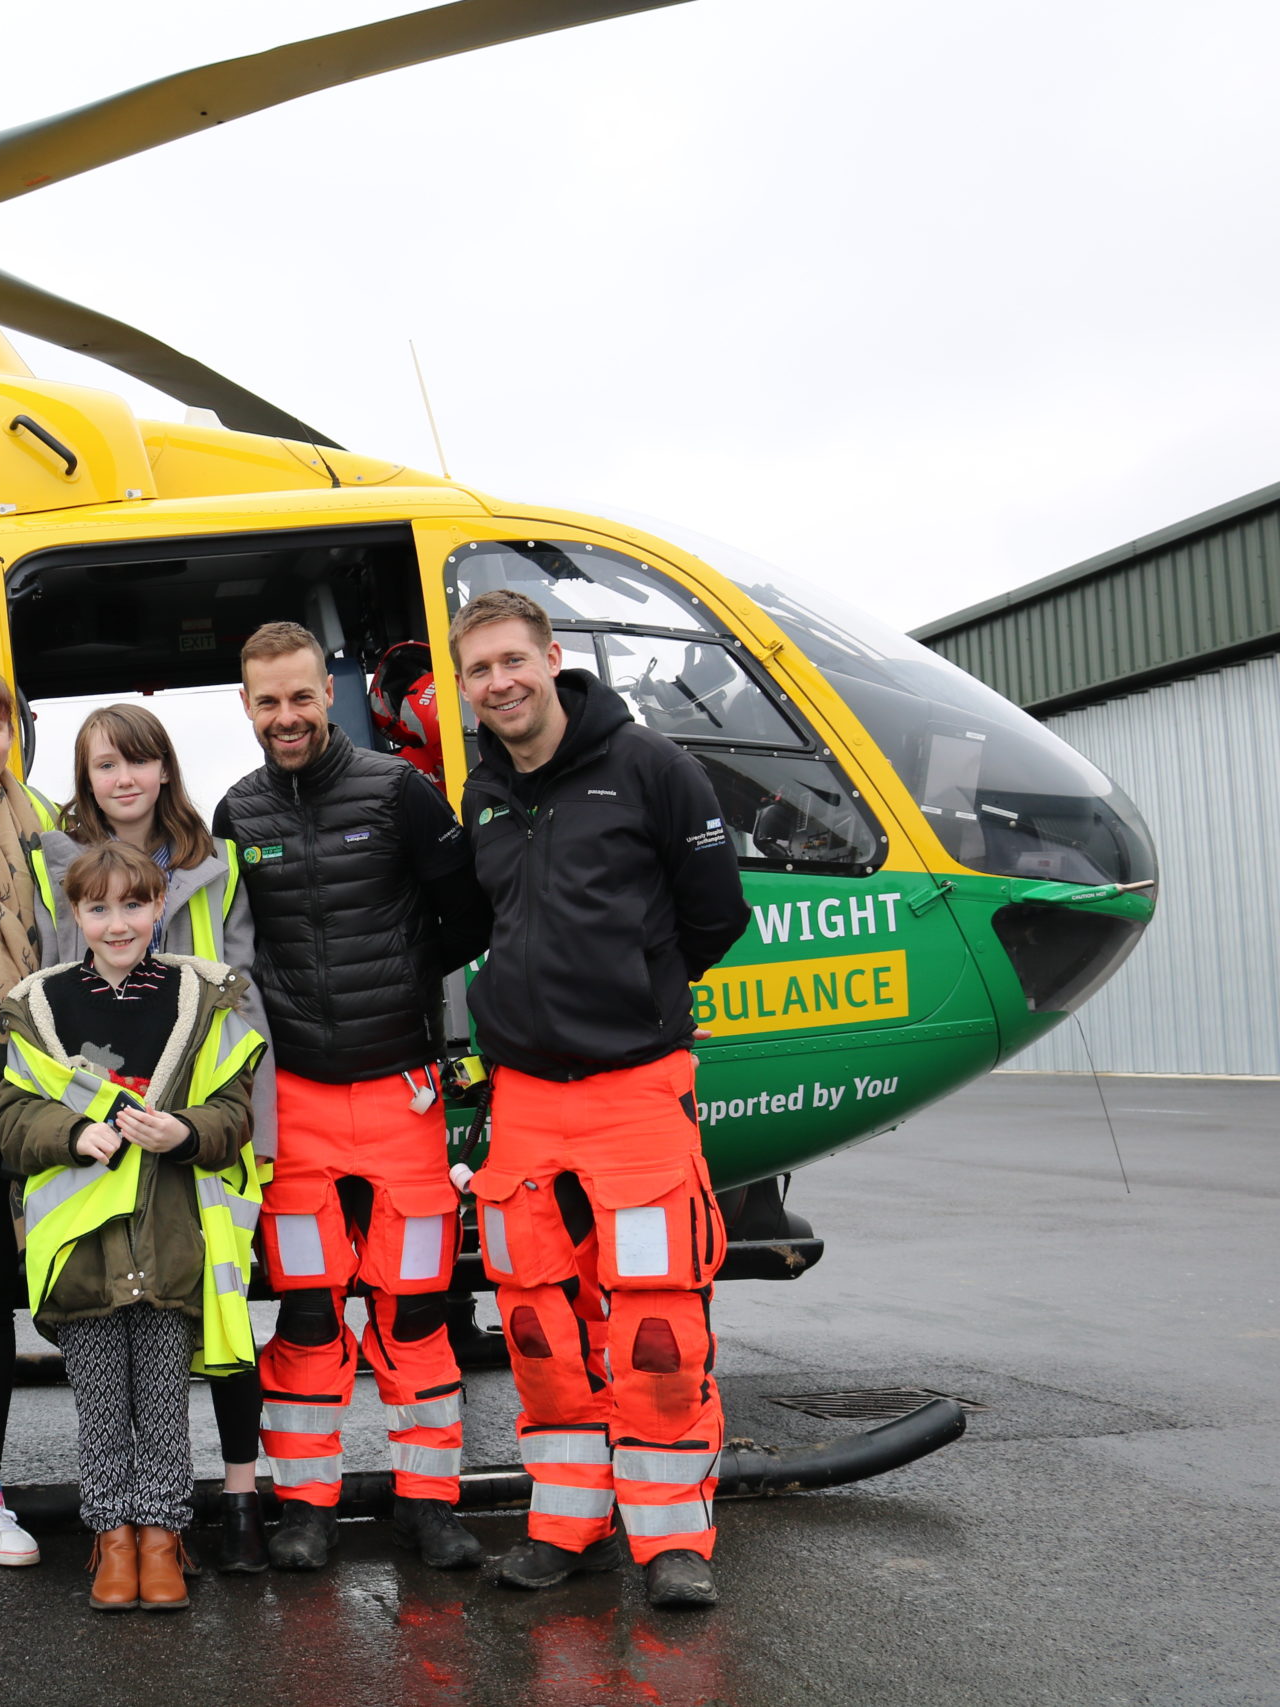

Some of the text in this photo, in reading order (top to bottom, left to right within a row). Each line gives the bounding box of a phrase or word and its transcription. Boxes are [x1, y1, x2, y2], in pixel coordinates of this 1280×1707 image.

[181, 635, 213, 649] EXIT
[753, 892, 901, 945] WIGHT
[691, 966, 894, 1024] BULANCE
[697, 1076, 899, 1126] pported by You
